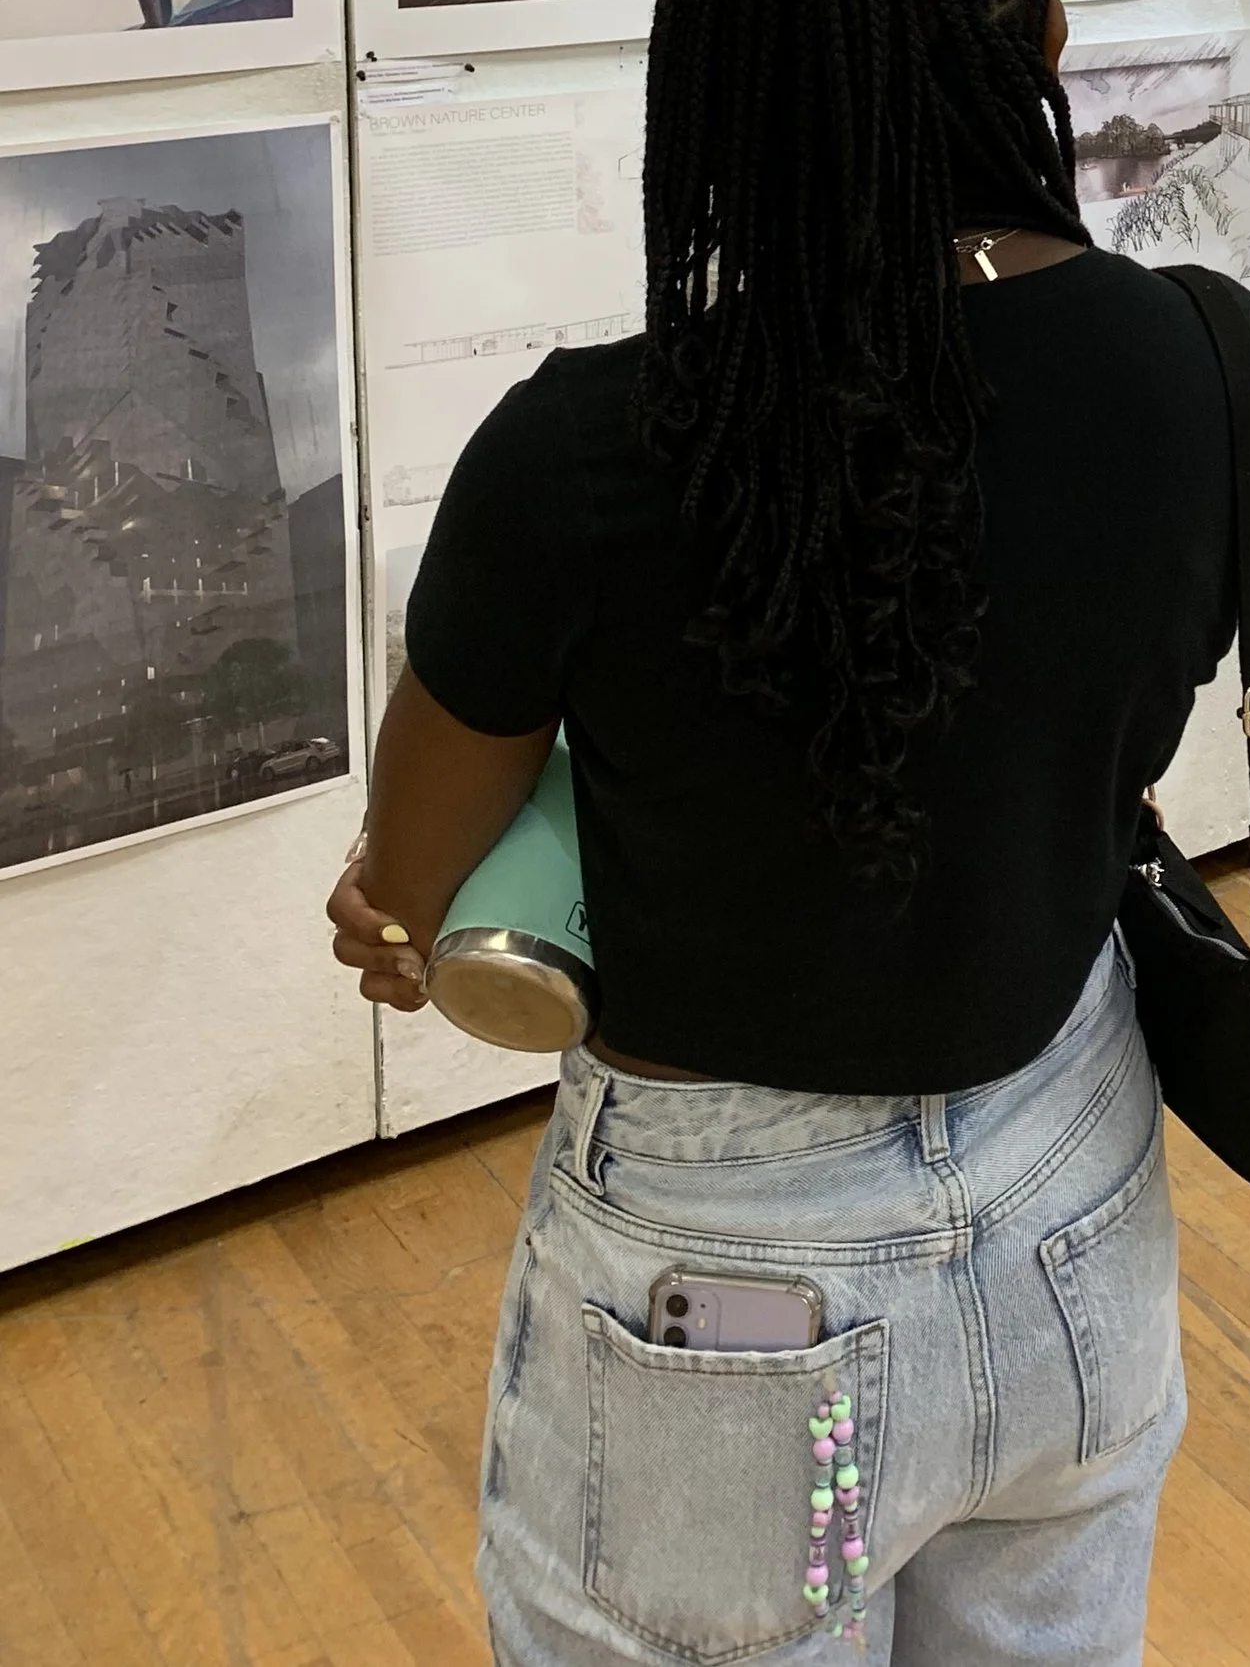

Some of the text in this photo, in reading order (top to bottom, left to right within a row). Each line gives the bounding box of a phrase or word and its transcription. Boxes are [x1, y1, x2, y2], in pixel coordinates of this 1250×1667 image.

[368, 103, 547, 131] BROWN NATURE CENTER
